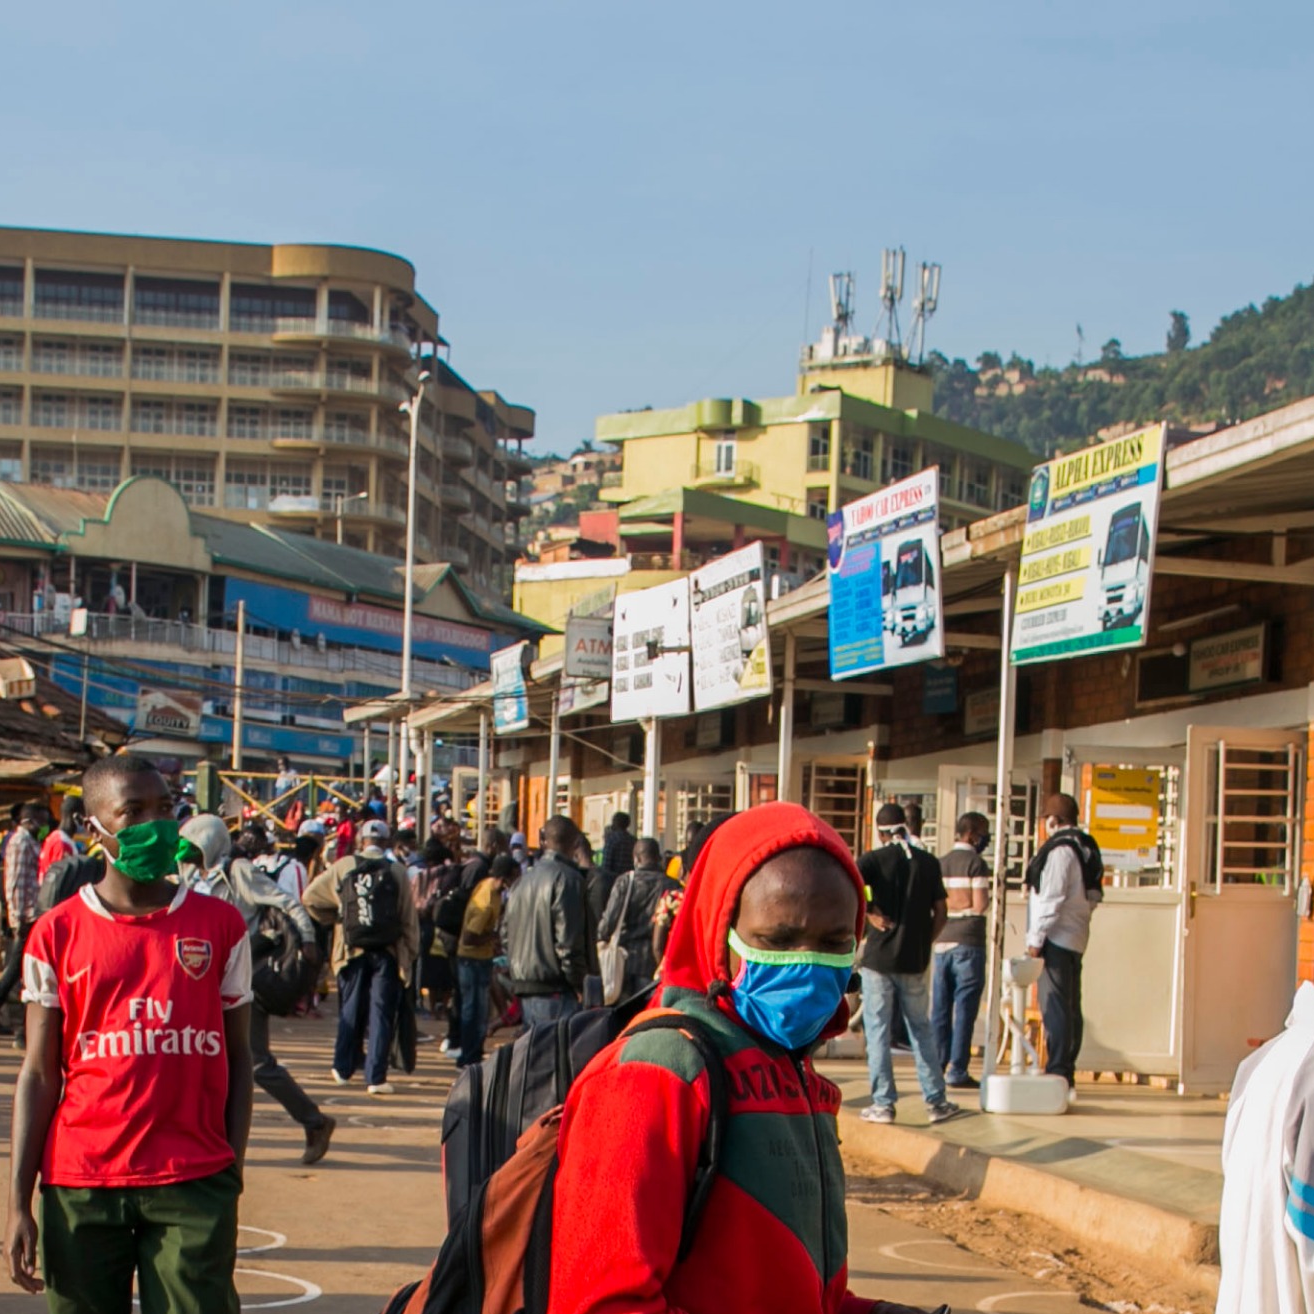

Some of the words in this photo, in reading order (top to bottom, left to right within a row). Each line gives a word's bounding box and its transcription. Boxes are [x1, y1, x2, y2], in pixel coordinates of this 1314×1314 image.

[1054, 453, 1090, 491] ALPHA
[1091, 433, 1145, 477] EXPRESS
[575, 638, 612, 656] ATM
[146, 714, 190, 729] EQUITY
[129, 996, 173, 1024] Fly
[77, 1022, 221, 1062] Emirates
